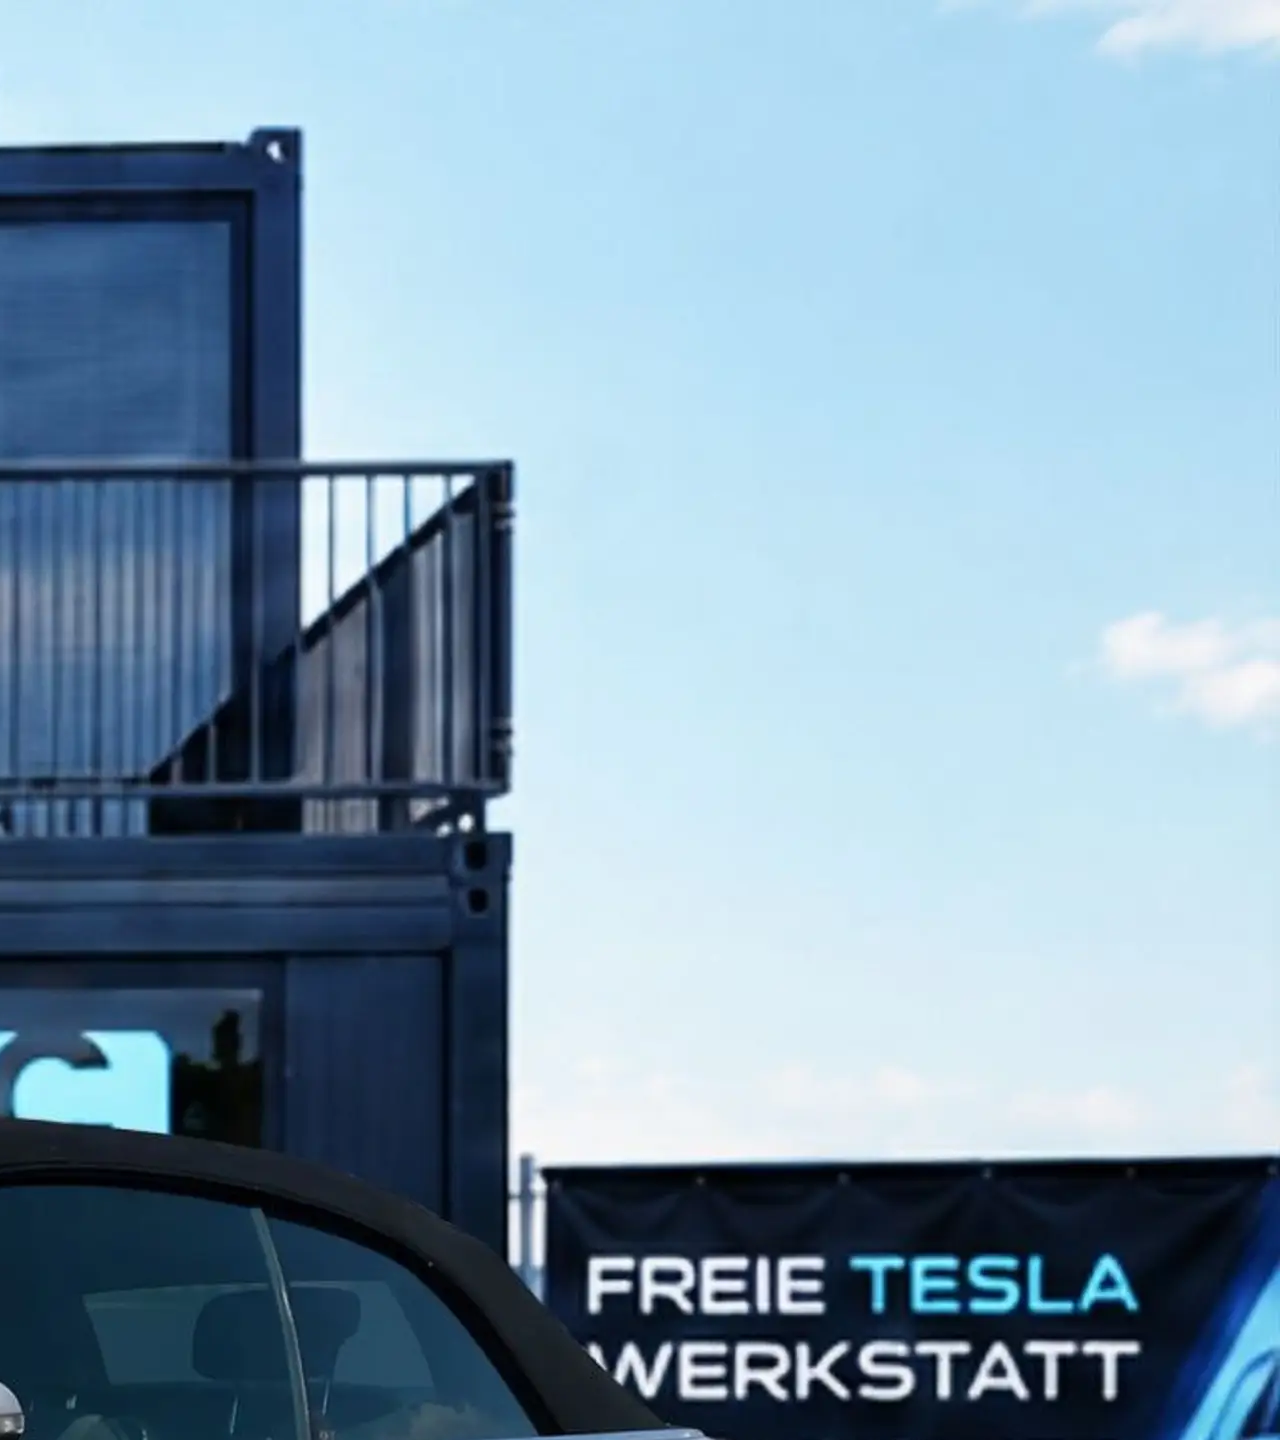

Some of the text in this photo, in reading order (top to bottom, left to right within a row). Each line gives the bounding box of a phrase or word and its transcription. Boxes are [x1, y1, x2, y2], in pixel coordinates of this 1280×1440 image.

[586, 1253, 1139, 1315] FREIE TESLA
[592, 1340, 1140, 1402] WERKSTATT
